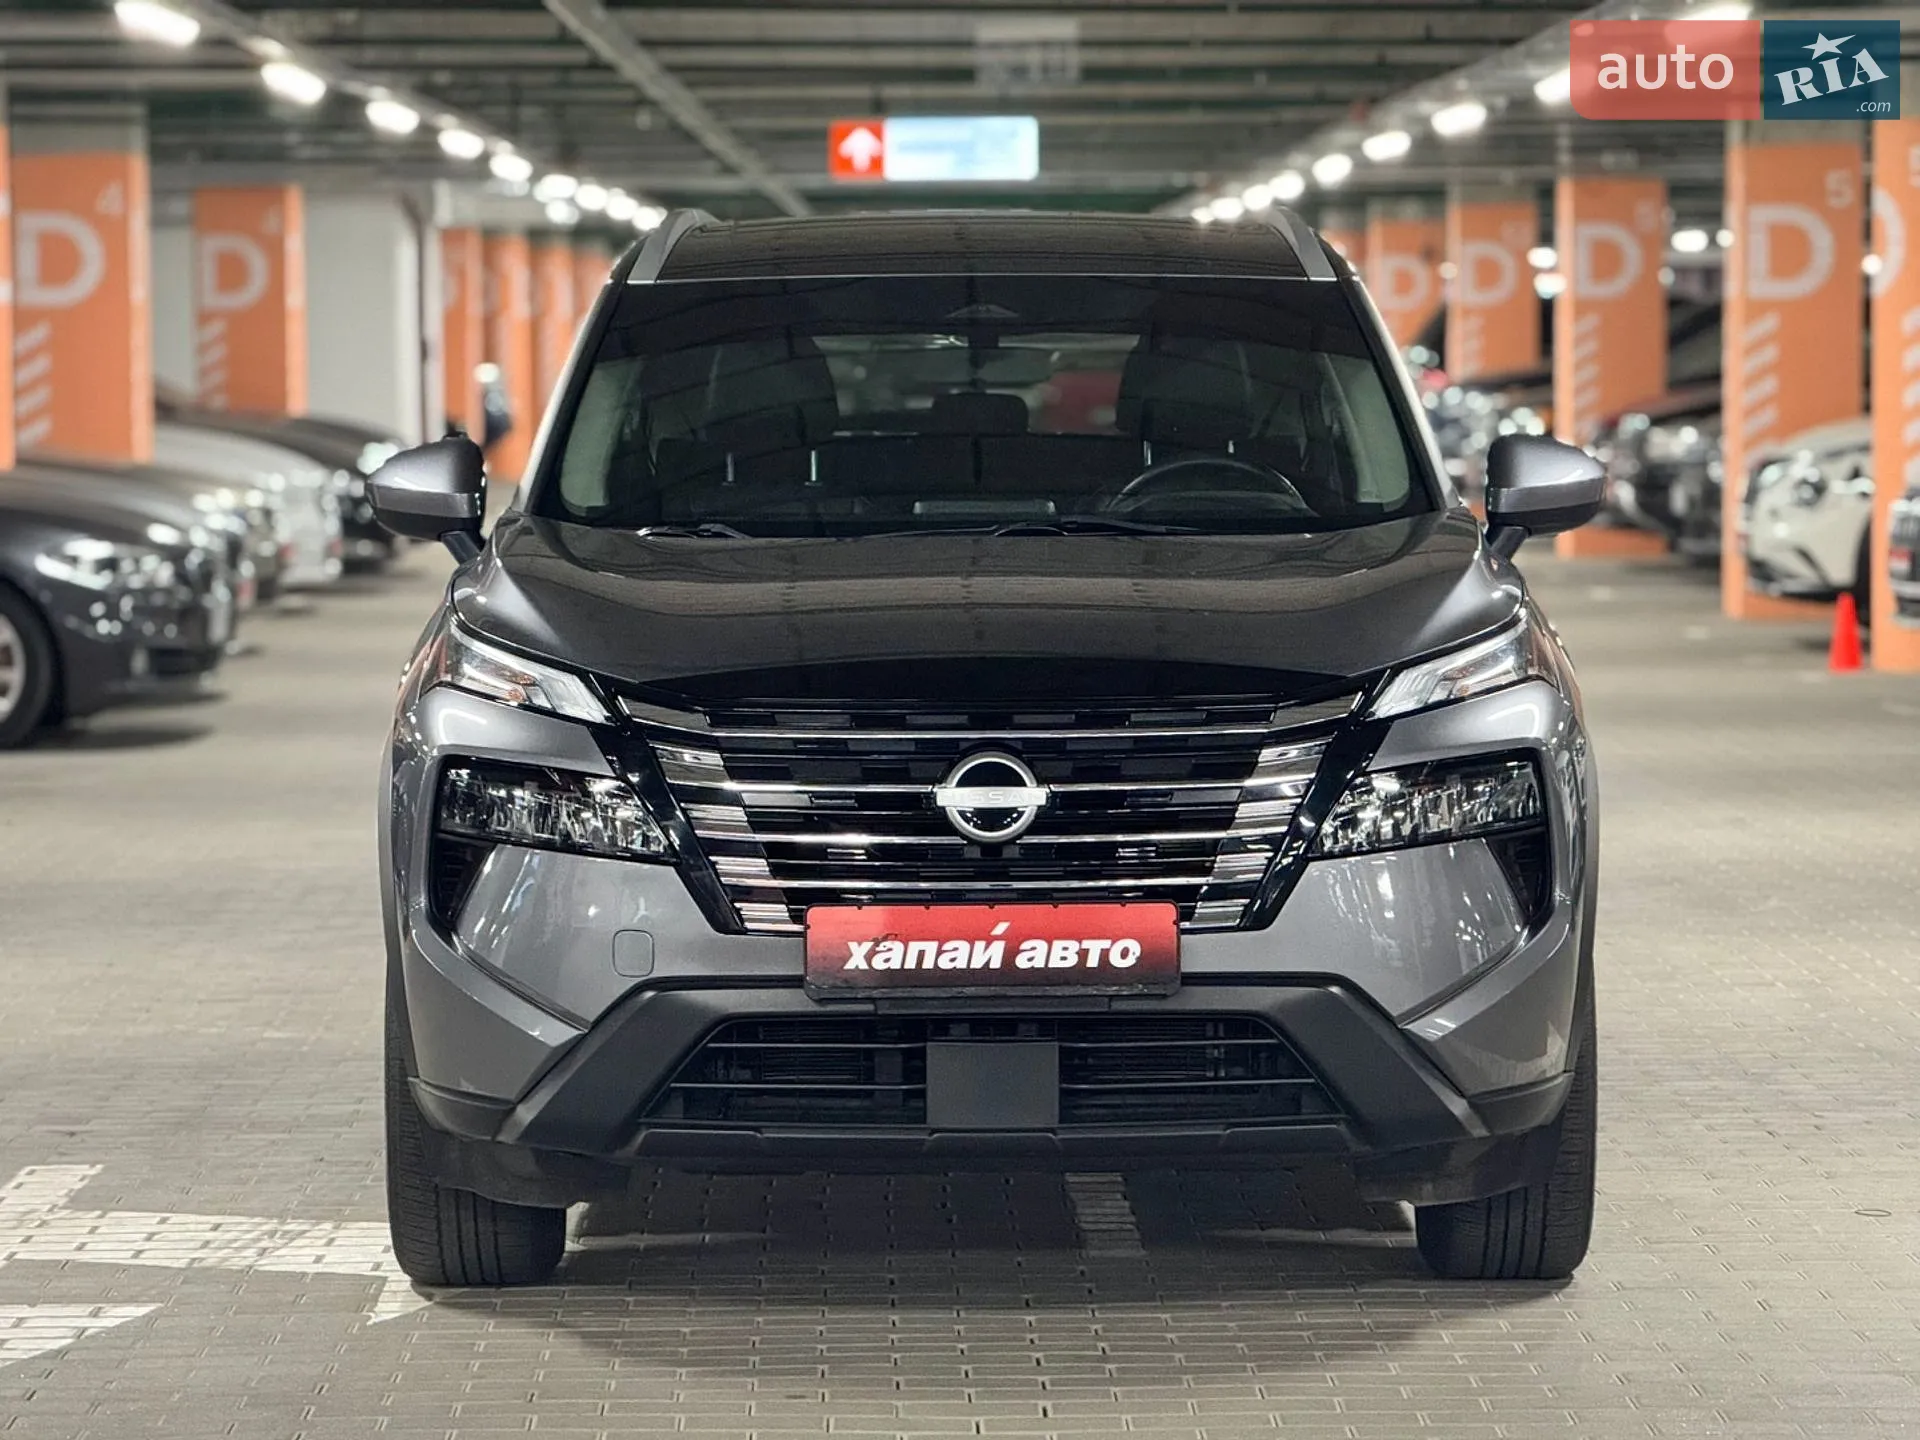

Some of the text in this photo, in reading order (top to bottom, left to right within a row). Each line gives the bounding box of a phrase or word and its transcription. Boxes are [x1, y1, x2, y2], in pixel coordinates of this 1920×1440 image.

[13, 209, 106, 308] D
[197, 233, 270, 311] D
[1460, 240, 1518, 306] D
[1575, 220, 1643, 299] D
[1747, 203, 1836, 300] D
[1015, 938, 1142, 969] авто
